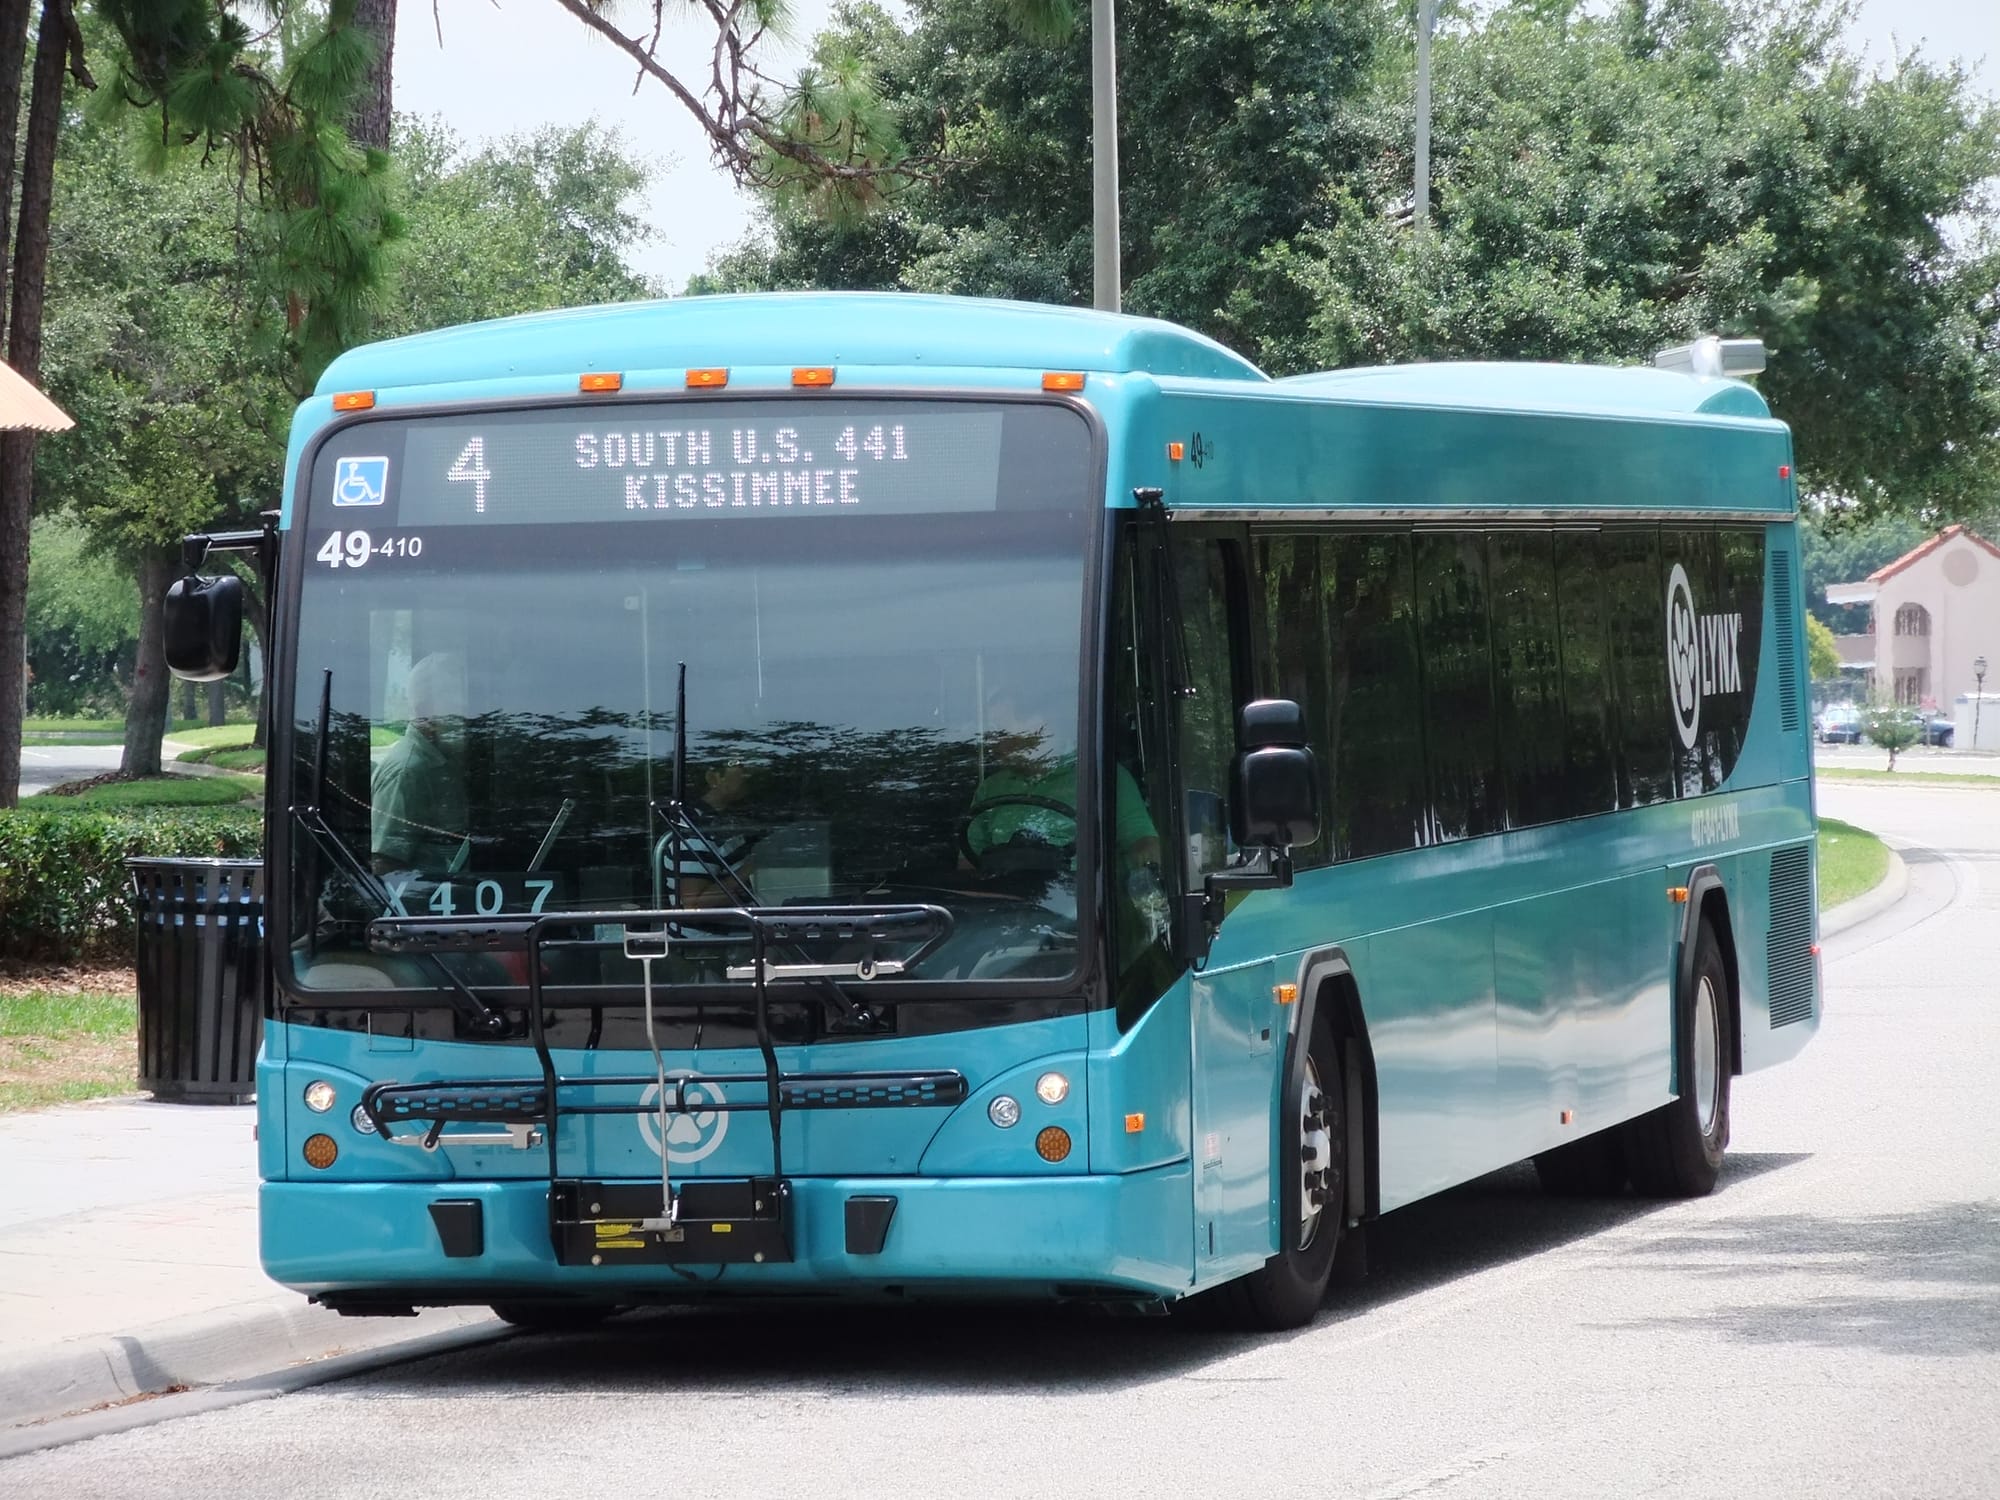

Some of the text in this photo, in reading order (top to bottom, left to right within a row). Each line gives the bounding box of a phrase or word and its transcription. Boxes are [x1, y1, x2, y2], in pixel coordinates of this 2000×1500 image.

[575, 425, 908, 468] SOUTH U.S. 441
[447, 437, 492, 513] 4
[624, 469, 859, 510] KISSIMMEE
[316, 529, 423, 569] 49-410
[1700, 612, 1742, 696] LYNX
